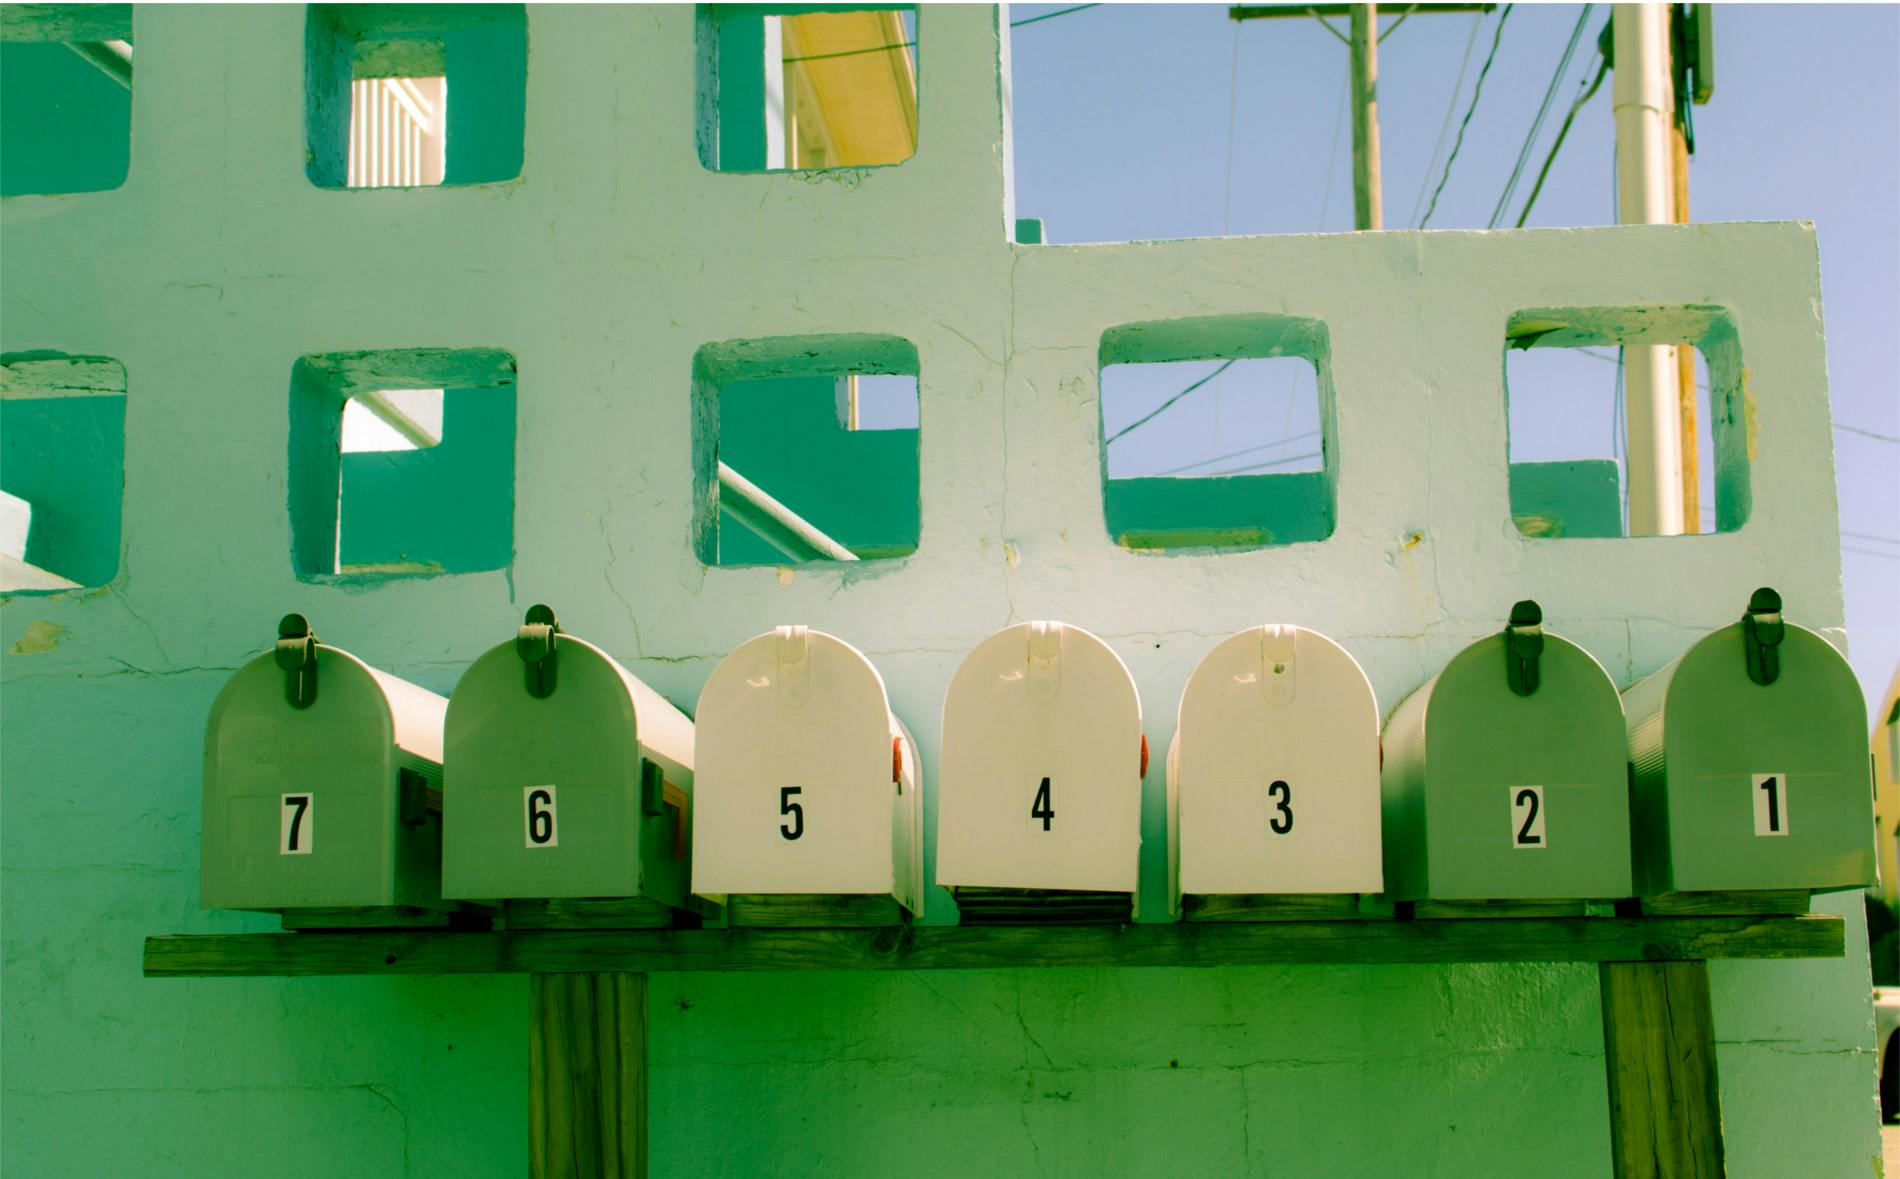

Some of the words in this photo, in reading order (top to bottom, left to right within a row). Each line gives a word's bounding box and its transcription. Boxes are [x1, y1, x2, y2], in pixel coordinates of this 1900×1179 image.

[285, 796, 308, 851] 7
[529, 789, 553, 844] 6
[780, 786, 804, 841] 5
[1031, 777, 1055, 832] 4
[1268, 780, 1293, 835] 3
[1516, 789, 1541, 844] 2
[1760, 776, 1779, 832] 1
